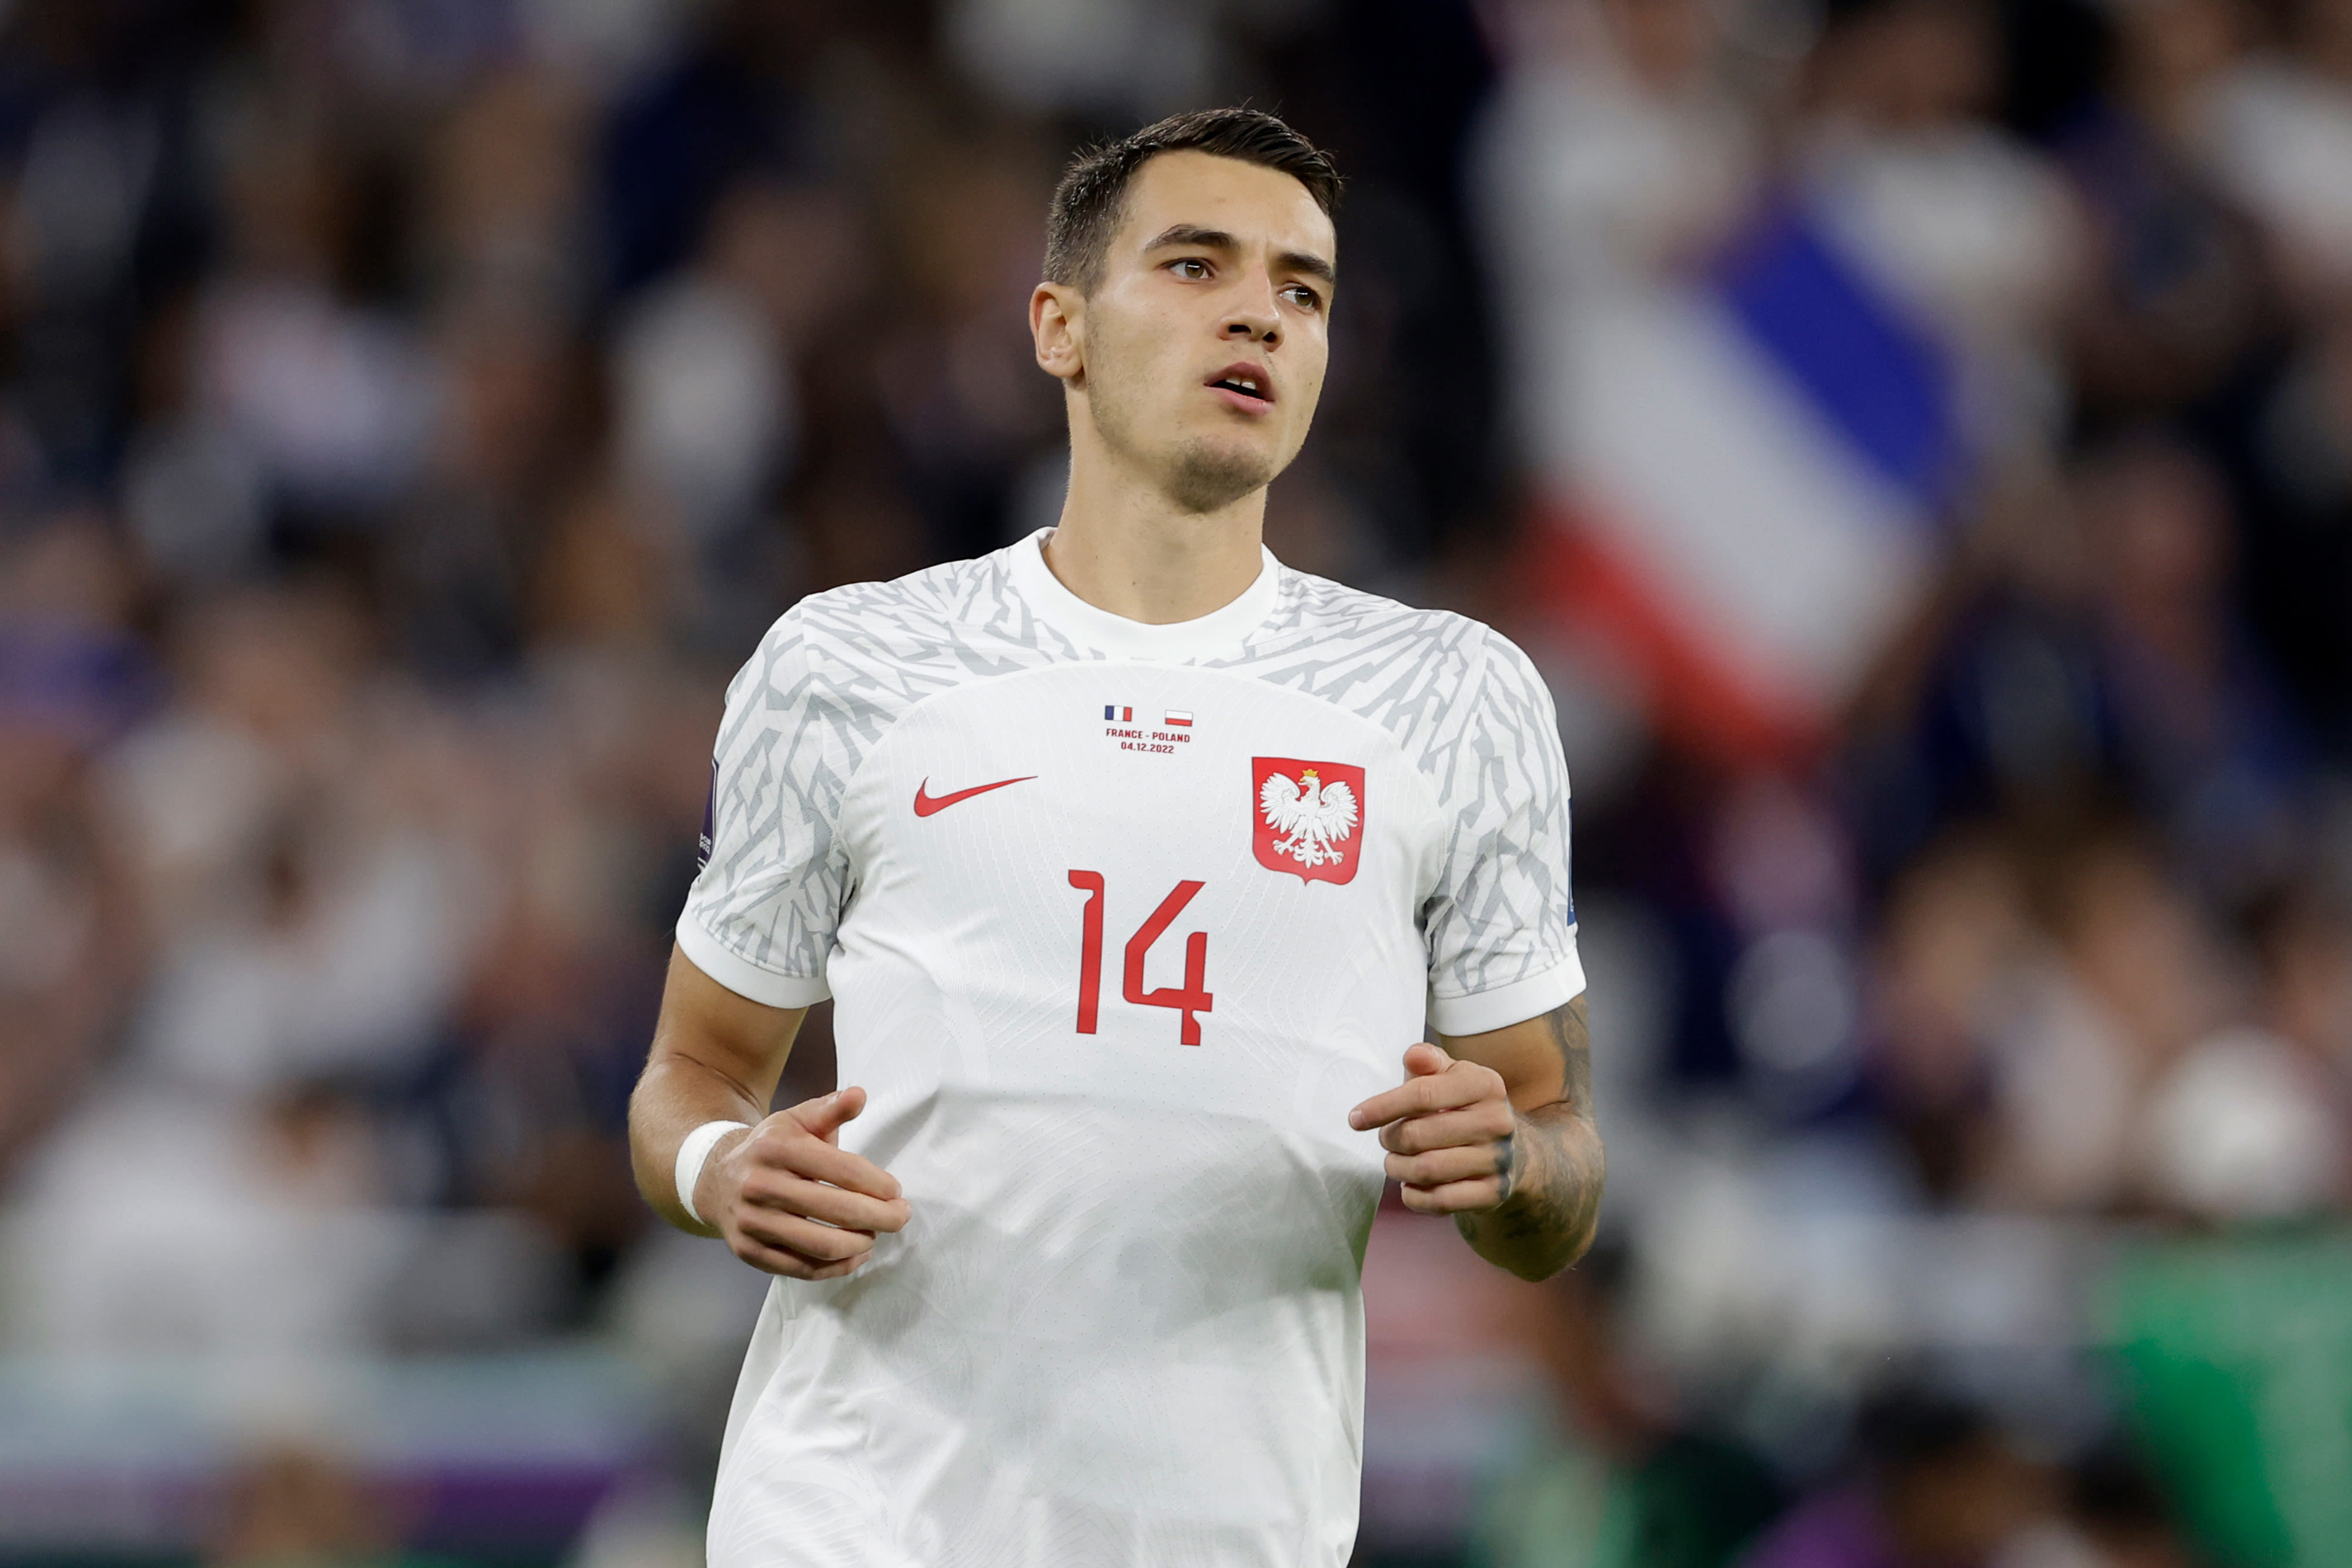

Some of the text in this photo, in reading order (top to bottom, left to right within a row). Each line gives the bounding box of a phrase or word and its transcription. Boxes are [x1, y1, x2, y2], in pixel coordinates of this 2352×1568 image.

[1106, 728, 1142, 738] FRANCE
[1152, 732, 1190, 743] POLAND
[1121, 741, 1174, 753] 04.12.2022
[1068, 869, 1213, 1046] 14
